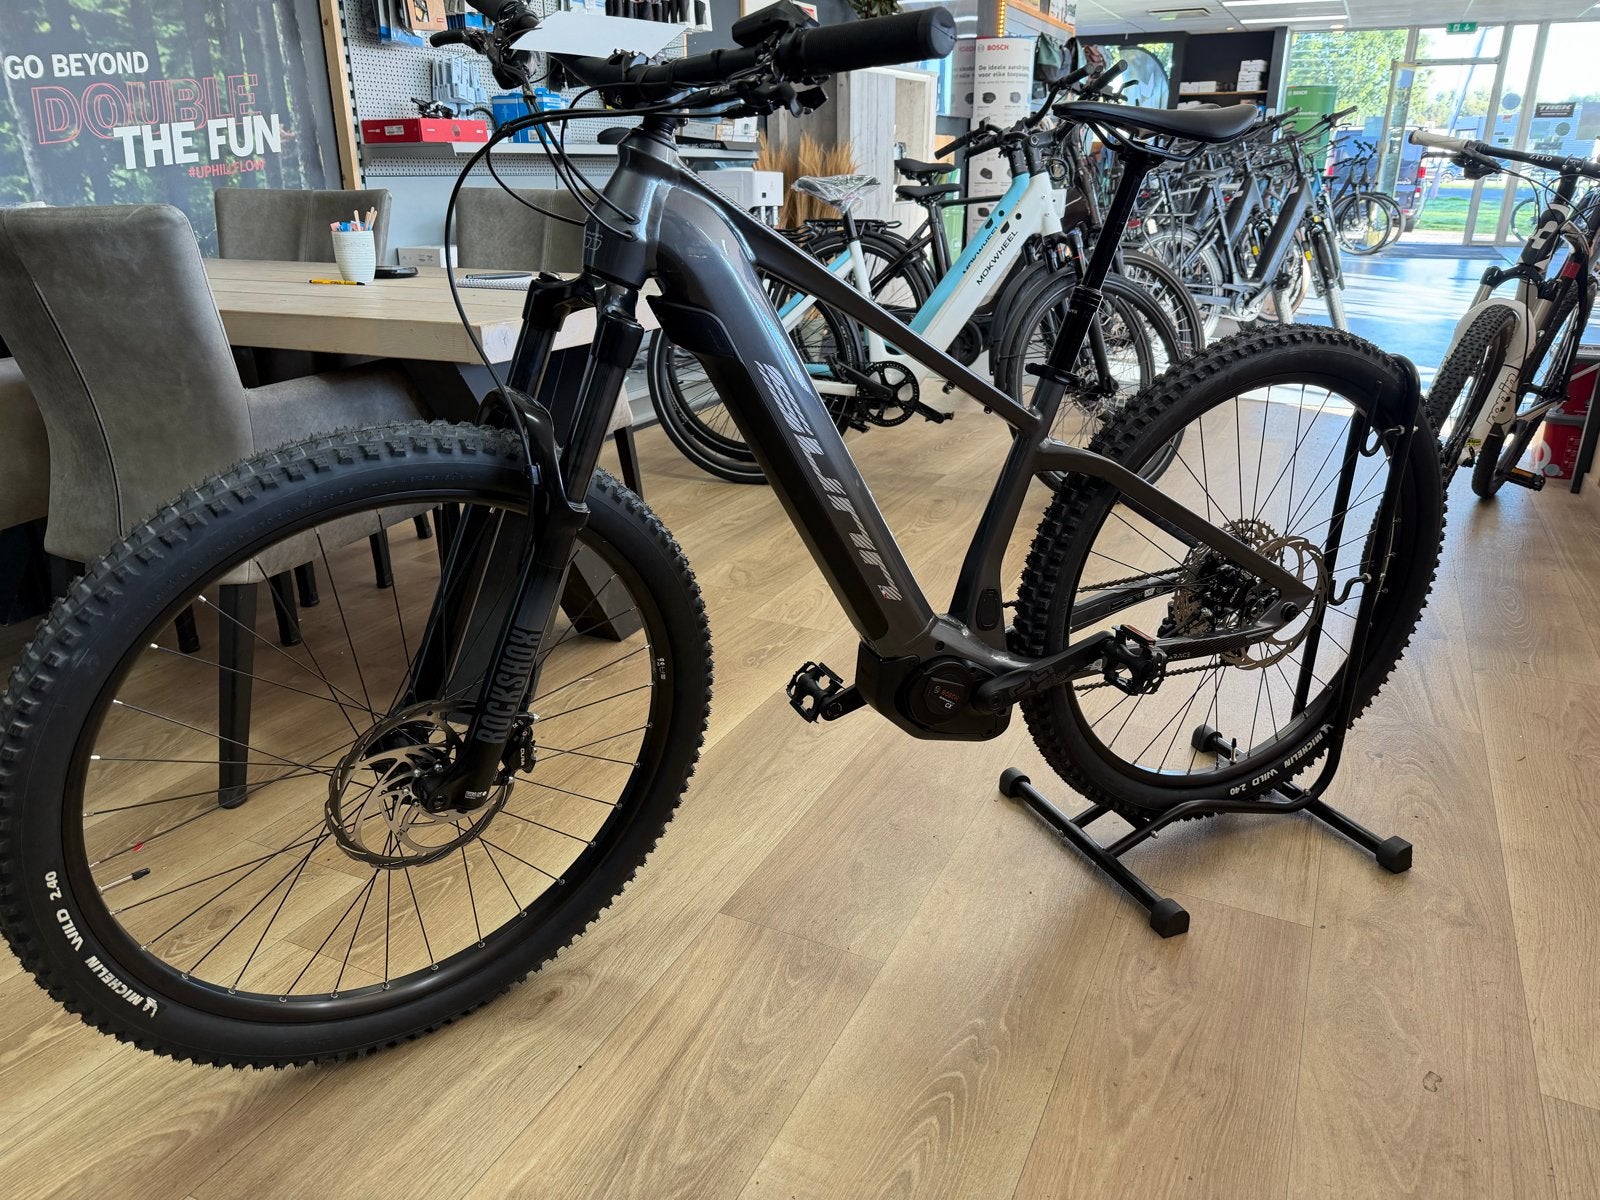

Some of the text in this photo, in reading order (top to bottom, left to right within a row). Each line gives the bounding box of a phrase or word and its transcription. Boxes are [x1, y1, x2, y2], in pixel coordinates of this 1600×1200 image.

[3, 51, 149, 80] GO BEYOND
[31, 74, 262, 145] DOUBLE
[113, 114, 282, 170] THE FUN
[188, 159, 266, 179] #UPHILLFLOW
[976, 231, 1019, 285] MOKWHEEL
[476, 626, 544, 744] ROCKSHOX
[1229, 732, 1324, 796] MICHELIN WILD 2.40
[44, 870, 145, 1007] MICHELIN WILD 2.40
